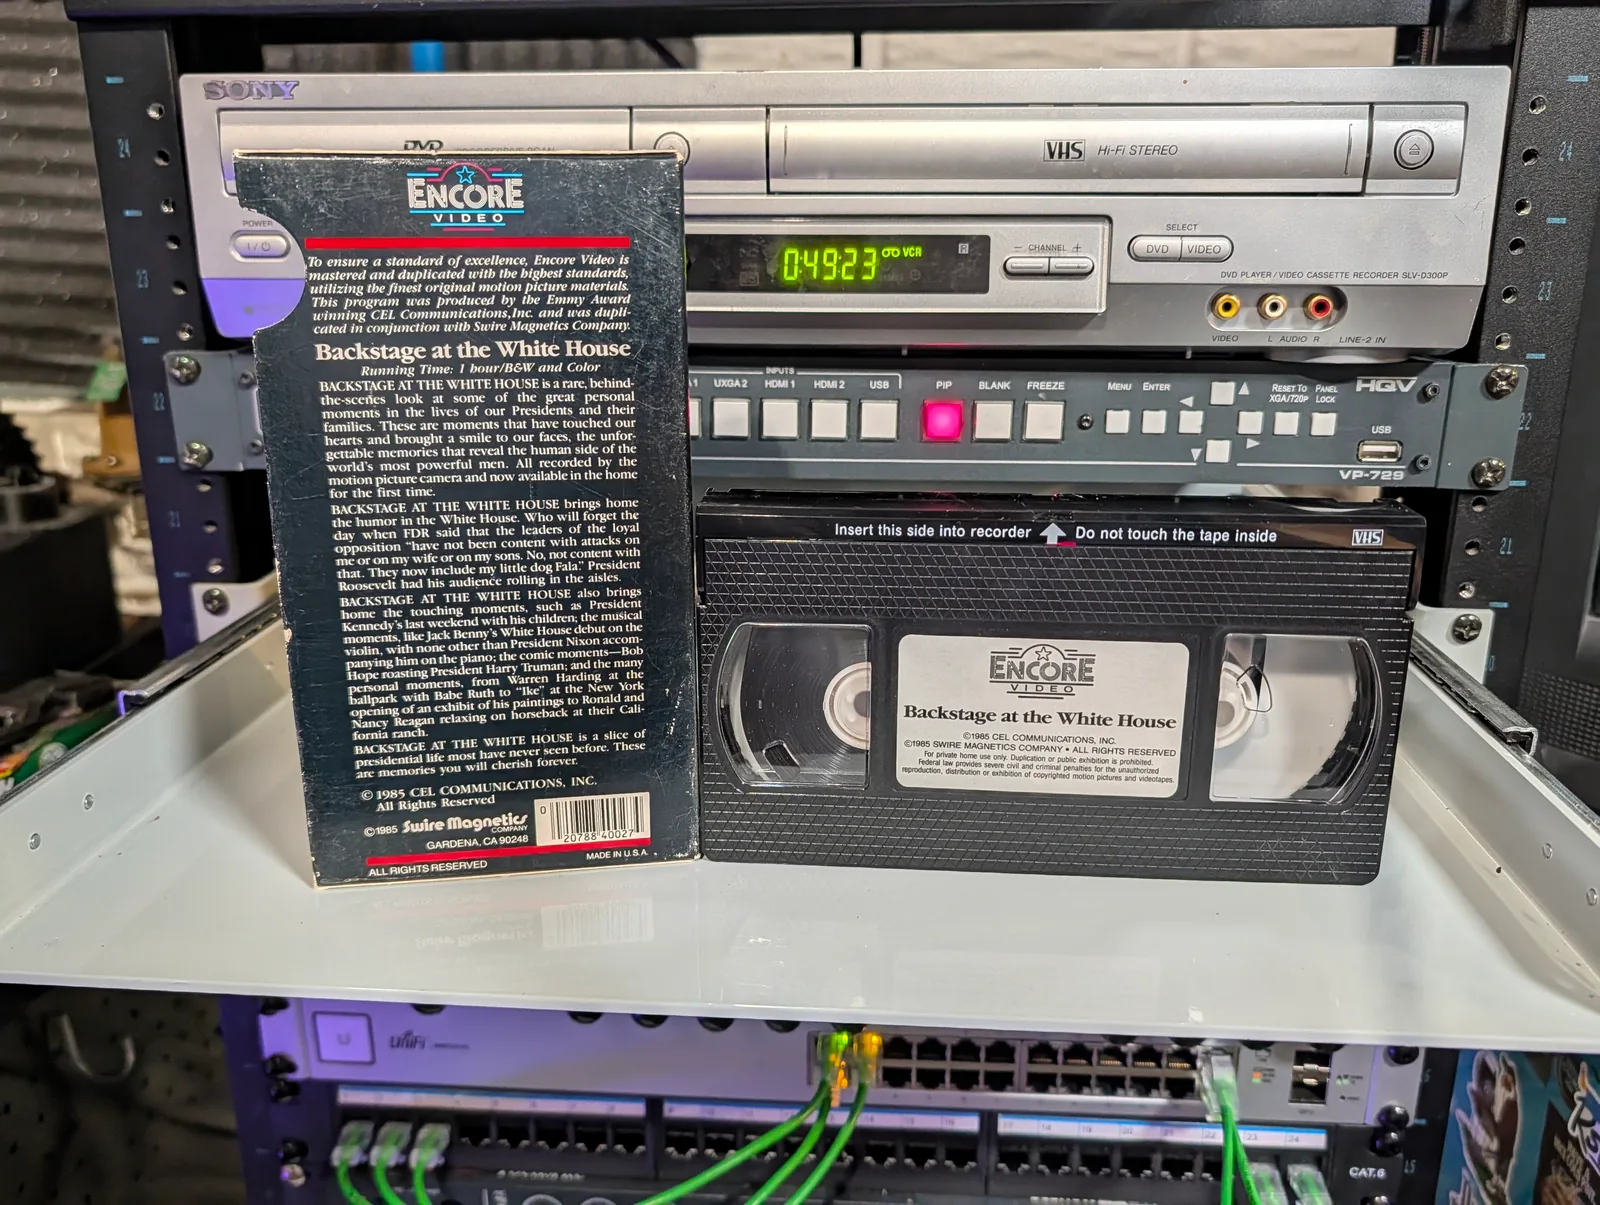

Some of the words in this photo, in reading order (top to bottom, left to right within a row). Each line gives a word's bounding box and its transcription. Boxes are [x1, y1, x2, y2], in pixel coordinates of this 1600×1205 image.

[203, 80, 299, 100] SONY
[1046, 141, 1083, 160] VHS
[1097, 145, 1126, 156] Hi-Fi
[1129, 145, 1178, 156] STEREO
[407, 178, 524, 209] ENCORE
[433, 214, 503, 223] VIDEO
[1166, 223, 1198, 231] SELECT
[903, 247, 922, 257] VCR
[1146, 245, 1169, 253] DVD
[1187, 245, 1222, 254] VIDEO
[308, 256, 322, 266] To
[326, 258, 368, 267] ensure
[373, 258, 381, 266] a
[386, 255, 443, 266] standard
[447, 255, 462, 268] of
[464, 255, 527, 268] excellence,
[534, 255, 575, 265] Encore
[582, 254, 614, 265] Video
[619, 254, 629, 265] is
[1221, 271, 1238, 279] DVD
[1307, 271, 1350, 279] CASSETTE
[1353, 271, 1399, 279] RECORDER
[1401, 271, 1449, 279] SLV-D300P
[1279, 335, 1307, 343] AUDIO
[1313, 335, 1320, 343] R
[1339, 336, 1372, 344] LINE-2
[1375, 336, 1387, 344] IN
[315, 343, 426, 364] Backstage
[431, 344, 452, 358] at
[456, 340, 490, 358] the
[494, 340, 559, 357] White
[564, 339, 632, 356] House
[361, 363, 414, 377] Running
[420, 364, 453, 374] Time:
[460, 363, 464, 373] 1
[470, 362, 535, 373] hour/B&W
[538, 362, 562, 372] and
[567, 362, 600, 372] Color
[765, 367, 795, 375] INPUTS
[714, 379, 741, 388] UXGA
[742, 380, 748, 388] 2
[765, 380, 788, 388] HDMI
[790, 380, 796, 388] 1
[814, 380, 838, 389] HDMI
[839, 380, 846, 389] 2
[869, 380, 890, 389] USB
[936, 381, 952, 389] PIP
[978, 381, 1011, 390] BLANK
[1027, 381, 1065, 390] FREEZE
[1355, 379, 1418, 393] HQV
[1371, 425, 1392, 434] USB
[1339, 470, 1405, 481] VP-729
[835, 523, 874, 536] Insert
[877, 524, 902, 537] this
[906, 524, 935, 537] side
[939, 524, 966, 538] into
[970, 526, 1032, 538] recorder
[1075, 526, 1095, 540] Do
[1100, 528, 1123, 541] not
[1128, 527, 1167, 541] touch
[1172, 527, 1195, 542] the
[1200, 529, 1230, 544] tape
[1235, 529, 1277, 543] inside
[1354, 531, 1382, 544] VHS
[338, 580, 396, 591] Roosevelt
[400, 579, 423, 588] had
[427, 578, 444, 588] his
[449, 577, 502, 588] audience
[507, 575, 545, 586] rolling
[550, 574, 560, 584] in
[565, 573, 583, 583] the
[588, 572, 621, 582] aisles.
[989, 655, 1095, 682] ENCORE
[1010, 684, 1074, 693] VIDEO
[903, 705, 997, 725] Backstage
[1001, 711, 1019, 723] at
[1022, 710, 1053, 724] the
[1057, 711, 1113, 727] White
[1117, 714, 1177, 729] House
[1012, 734, 1097, 744] COMMUNICATIONS,
[933, 741, 962, 749] SWIRE
[964, 742, 1016, 751] MAGNETICS
[1018, 744, 1064, 753] COMPANY
[1091, 747, 1126, 755] RIGHTS
[1127, 748, 1177, 757] RESERVED
[936, 751, 958, 759] private
[959, 751, 978, 759] home
[1010, 754, 1046, 762] Duplication
[1057, 755, 1077, 764] public
[1078, 756, 1110, 764] exhibition
[1119, 758, 1154, 766] prohibited.
[355, 768, 374, 778] are
[378, 766, 435, 777] memories
[439, 765, 461, 775] you
[465, 761, 487, 771] will
[491, 758, 532, 770] cherish
[537, 758, 577, 766] forever.
[361, 790, 373, 800] ©
[376, 789, 405, 800] 1985
[409, 787, 435, 797] CEL
[439, 779, 565, 796] COMMUNICATIONS,
[572, 776, 597, 786] INC.
[376, 801, 393, 811] All
[398, 799, 436, 811] Rights
[441, 795, 495, 807] Reserved
[540, 806, 547, 815] 0
[402, 818, 445, 834] Swire
[447, 812, 528, 832] Magnetics
[491, 825, 528, 833] COMPANY
[564, 833, 597, 843] 20788
[601, 829, 634, 839] 40027
[426, 838, 482, 850] GARDENA,
[483, 837, 498, 846] CA
[499, 835, 529, 845] 90248
[586, 851, 611, 860] MADE
[368, 868, 389, 877] ALL
[390, 864, 429, 876] RIGHTS
[430, 860, 488, 872] RESERVED
[1349, 1167, 1386, 1179] CAT.6
